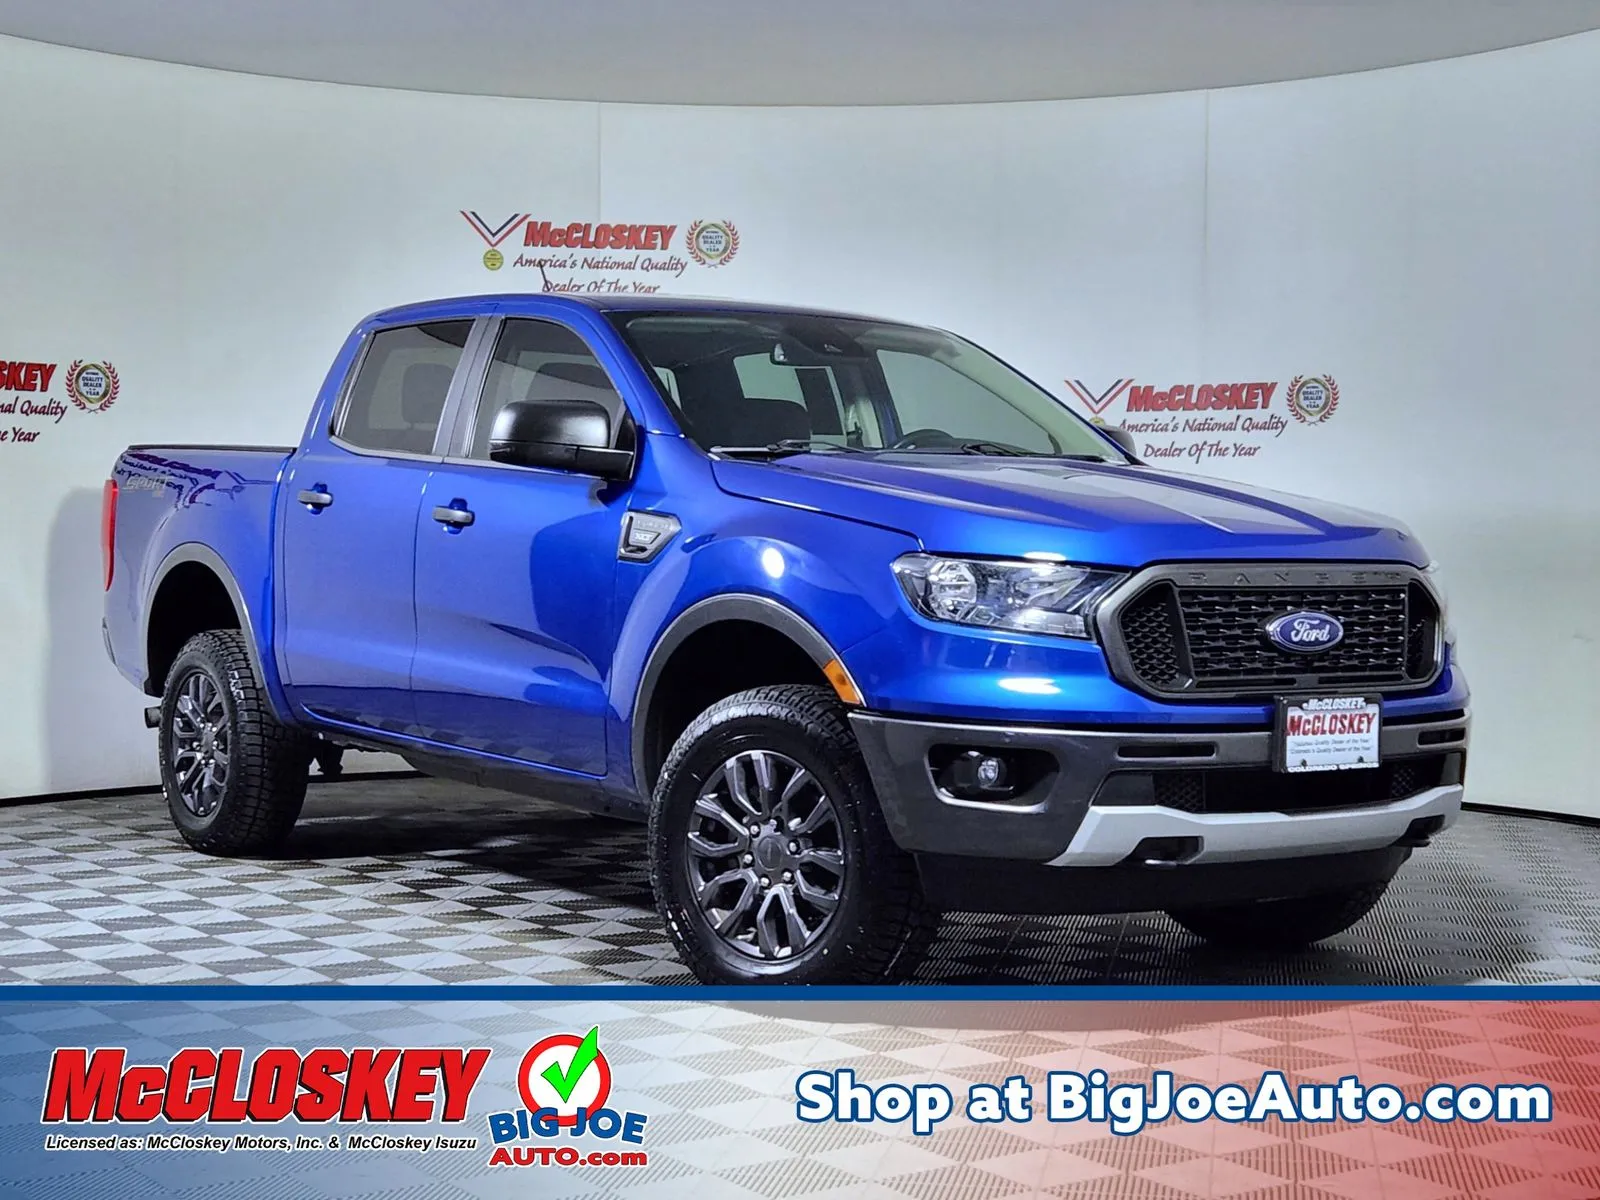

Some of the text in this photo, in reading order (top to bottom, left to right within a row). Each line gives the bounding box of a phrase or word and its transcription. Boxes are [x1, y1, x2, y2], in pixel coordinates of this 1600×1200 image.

[523, 221, 677, 250] McCLOSKEY
[513, 253, 578, 269] America's
[581, 255, 639, 271] National
[641, 255, 688, 278] Quality
[542, 277, 585, 292] Dealer
[607, 278, 629, 293] The
[632, 281, 661, 293] Year
[1126, 382, 1278, 413] McCLOSKEY
[20, 397, 68, 424] Quality
[11, 426, 40, 443] Year
[1119, 414, 1289, 438] America's National Quality
[1143, 440, 1261, 464] Dealer Of The Year
[1290, 619, 1330, 642] Ford
[1285, 713, 1376, 736] McCLOSKEY
